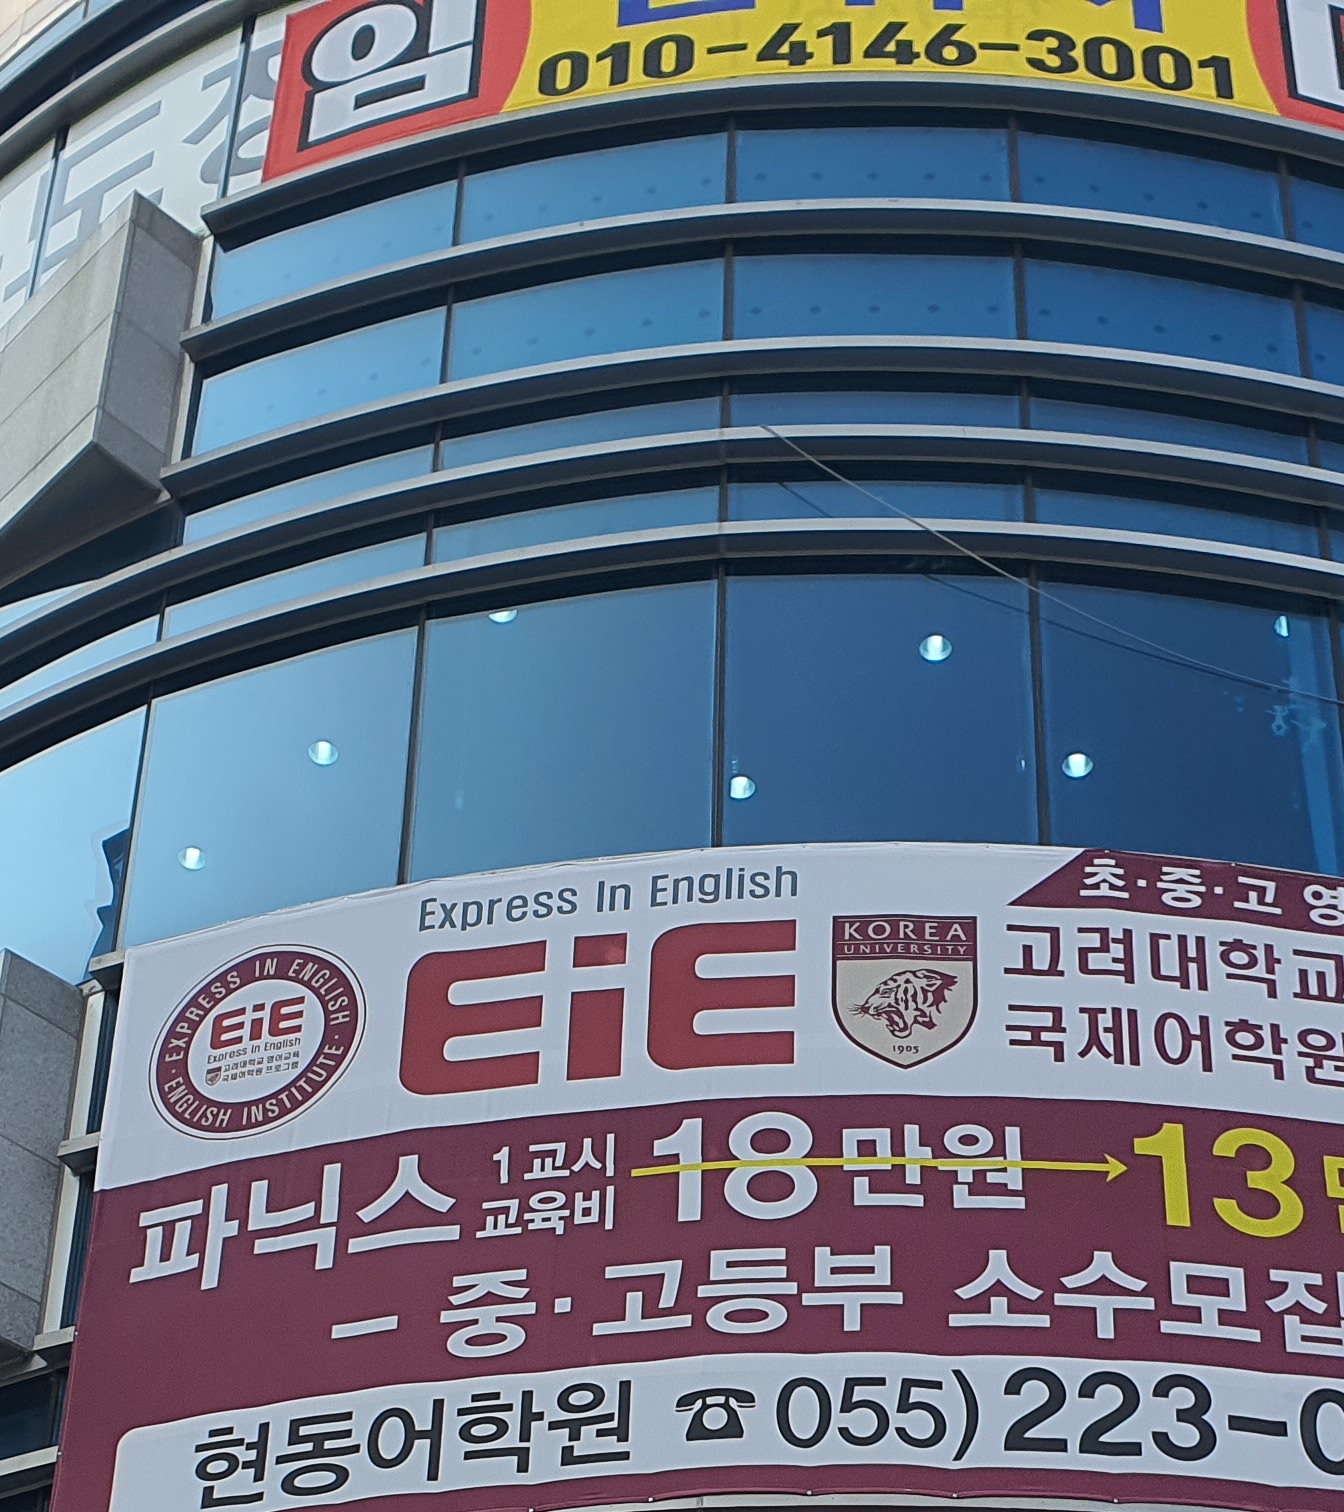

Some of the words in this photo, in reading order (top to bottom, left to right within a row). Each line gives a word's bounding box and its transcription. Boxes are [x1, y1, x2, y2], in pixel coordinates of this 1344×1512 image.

[299, 0, 481, 151] 임
[537, 20, 1235, 101] 010-4146-3001
[419, 885, 578, 932] Express
[596, 880, 631, 912] In
[650, 866, 799, 908] English
[844, 921, 967, 942] KOREA
[844, 944, 967, 957] UNIVERSITY
[164, 971, 241, 1062] EXPRESS
[255, 957, 277, 977] IN
[288, 959, 351, 1025] ENGLISH
[210, 996, 306, 1050] EiE
[399, 918, 797, 1096] EiE
[164, 1076, 232, 1128] ENGLISH
[242, 1044, 344, 1126] INSTITUTE
[892, 1044, 919, 1055] 1905
[492, 1133, 617, 1185] 1교시
[129, 1154, 461, 1291] 파닉스
[476, 1186, 617, 1240] 교육비
[439, 1245, 904, 1358] 중·고등부
[194, 1380, 633, 1509] 현동어학원
